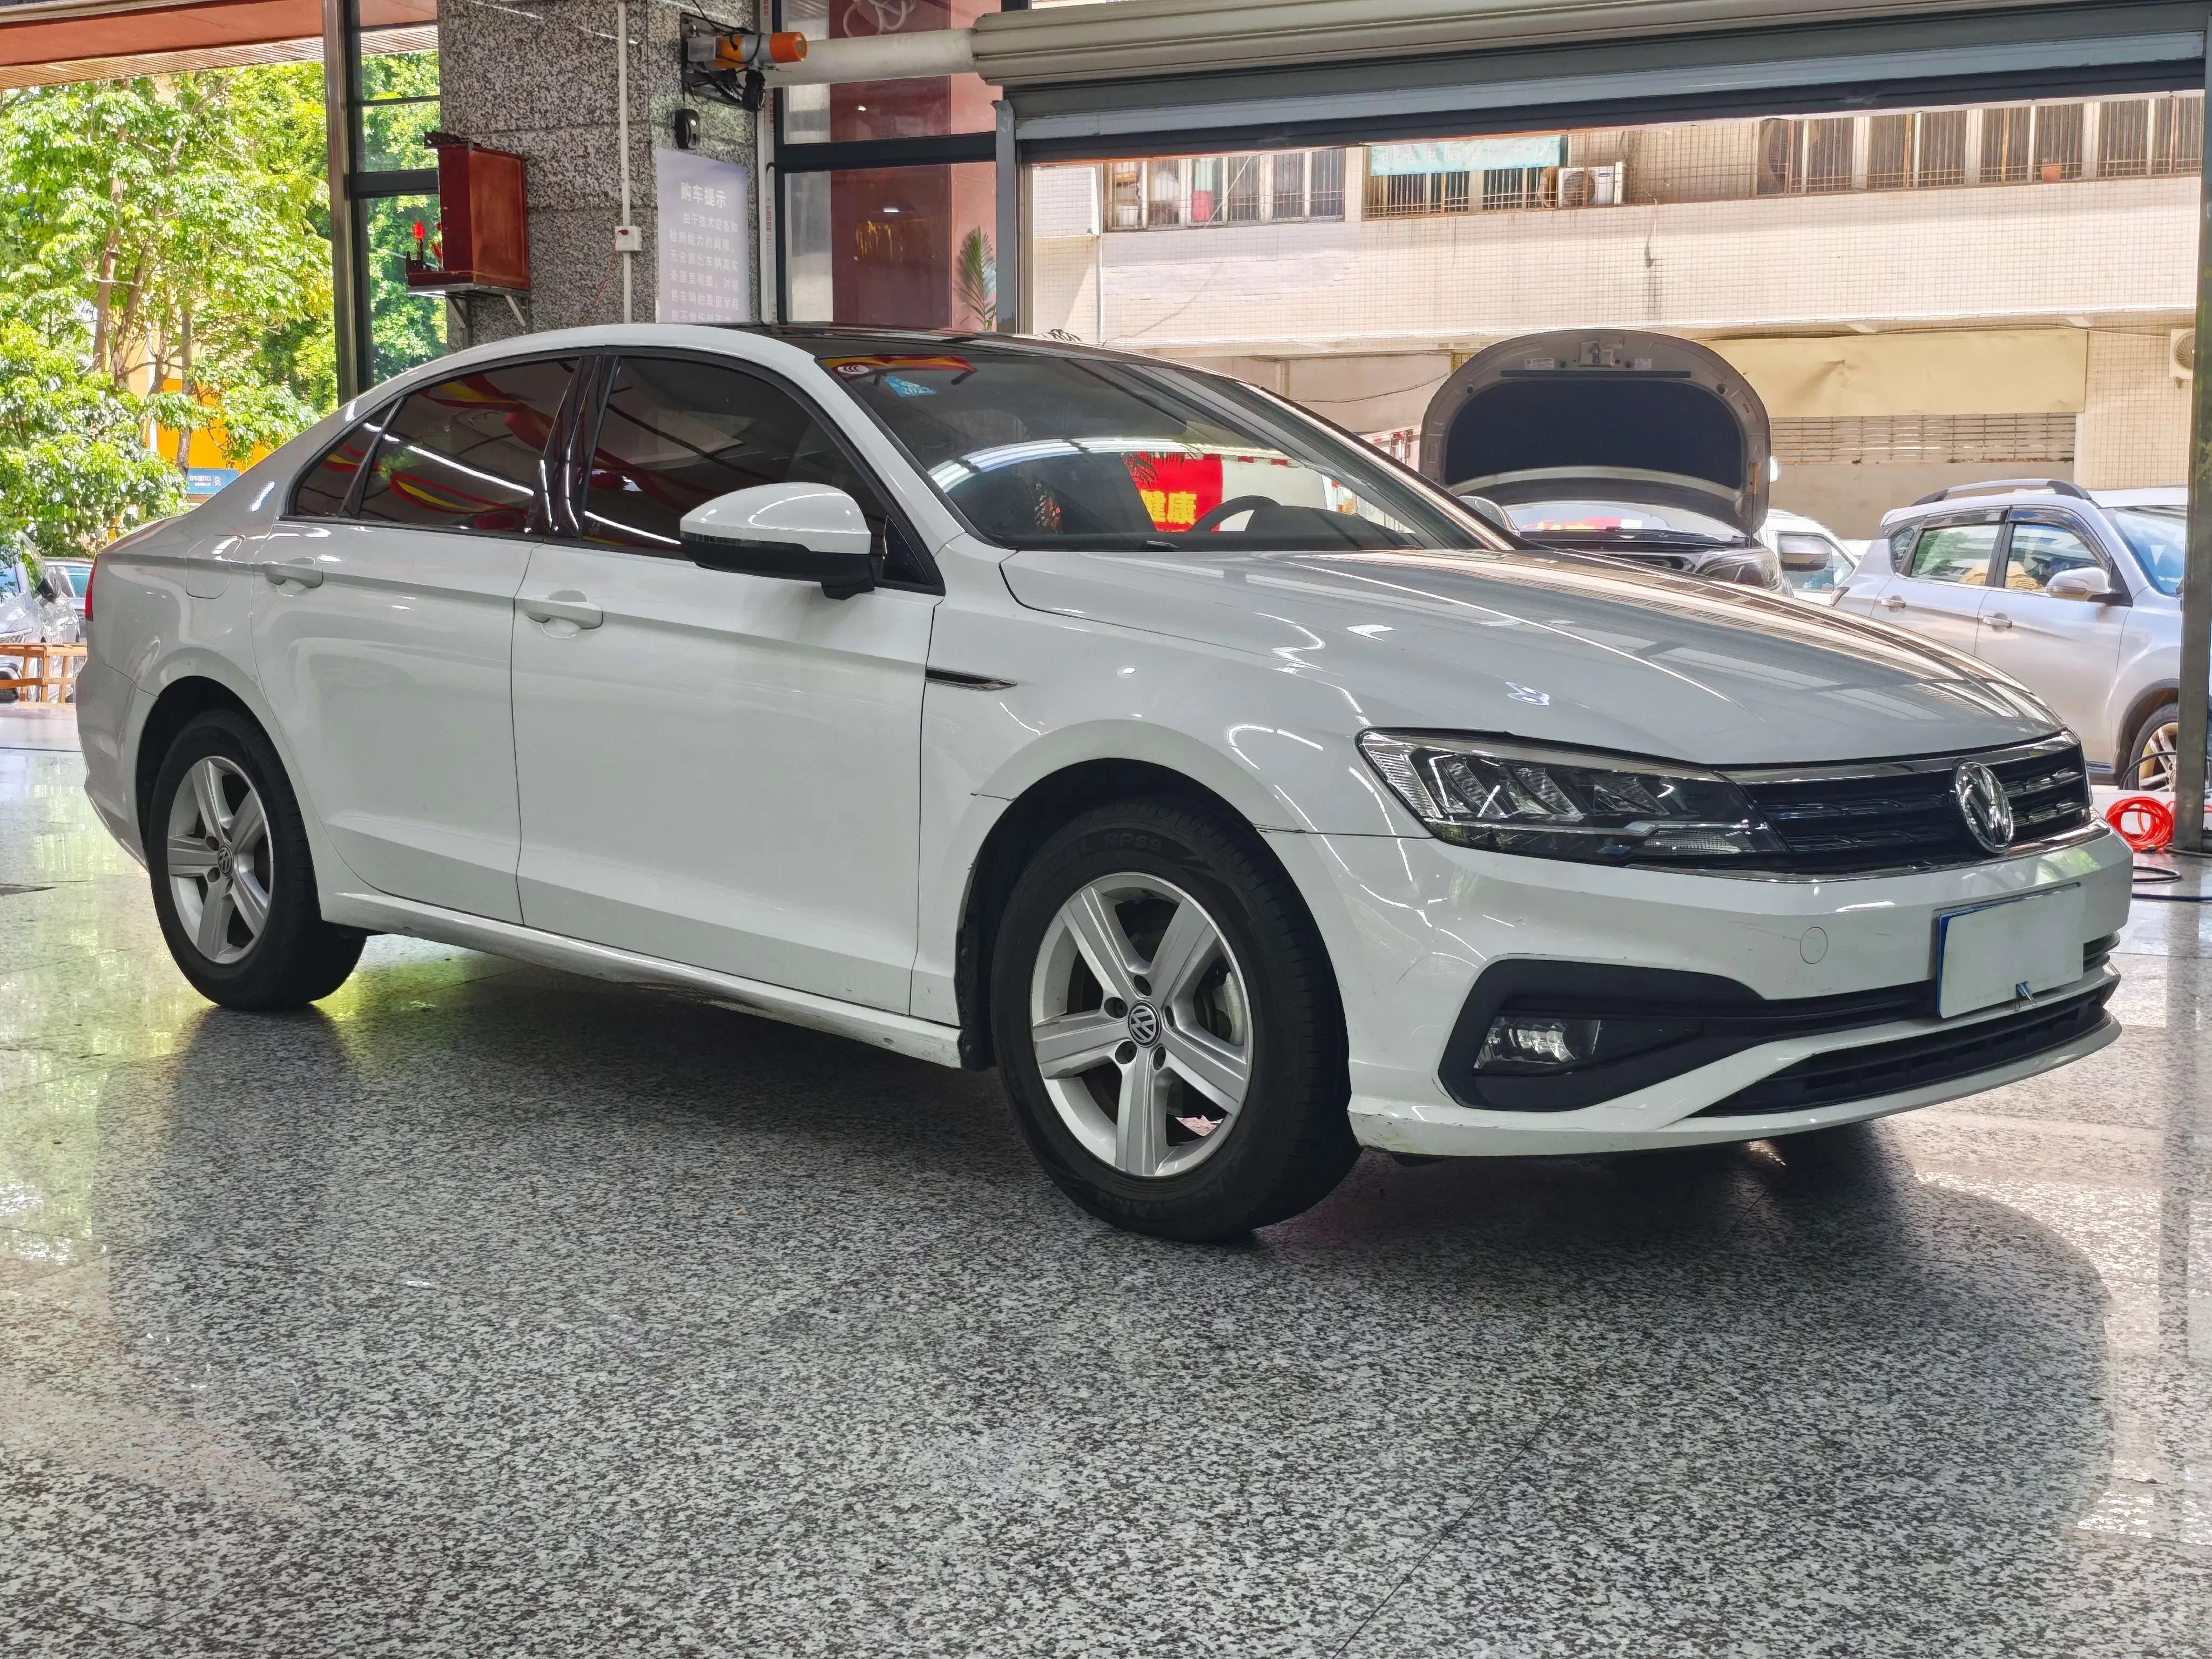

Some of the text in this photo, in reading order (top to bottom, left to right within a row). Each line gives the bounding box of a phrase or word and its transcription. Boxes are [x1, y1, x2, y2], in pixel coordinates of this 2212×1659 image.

[680, 181, 726, 208] 购车提示
[683, 212, 738, 233] 由于技术设备和
[1141, 489, 1197, 527] 健康
